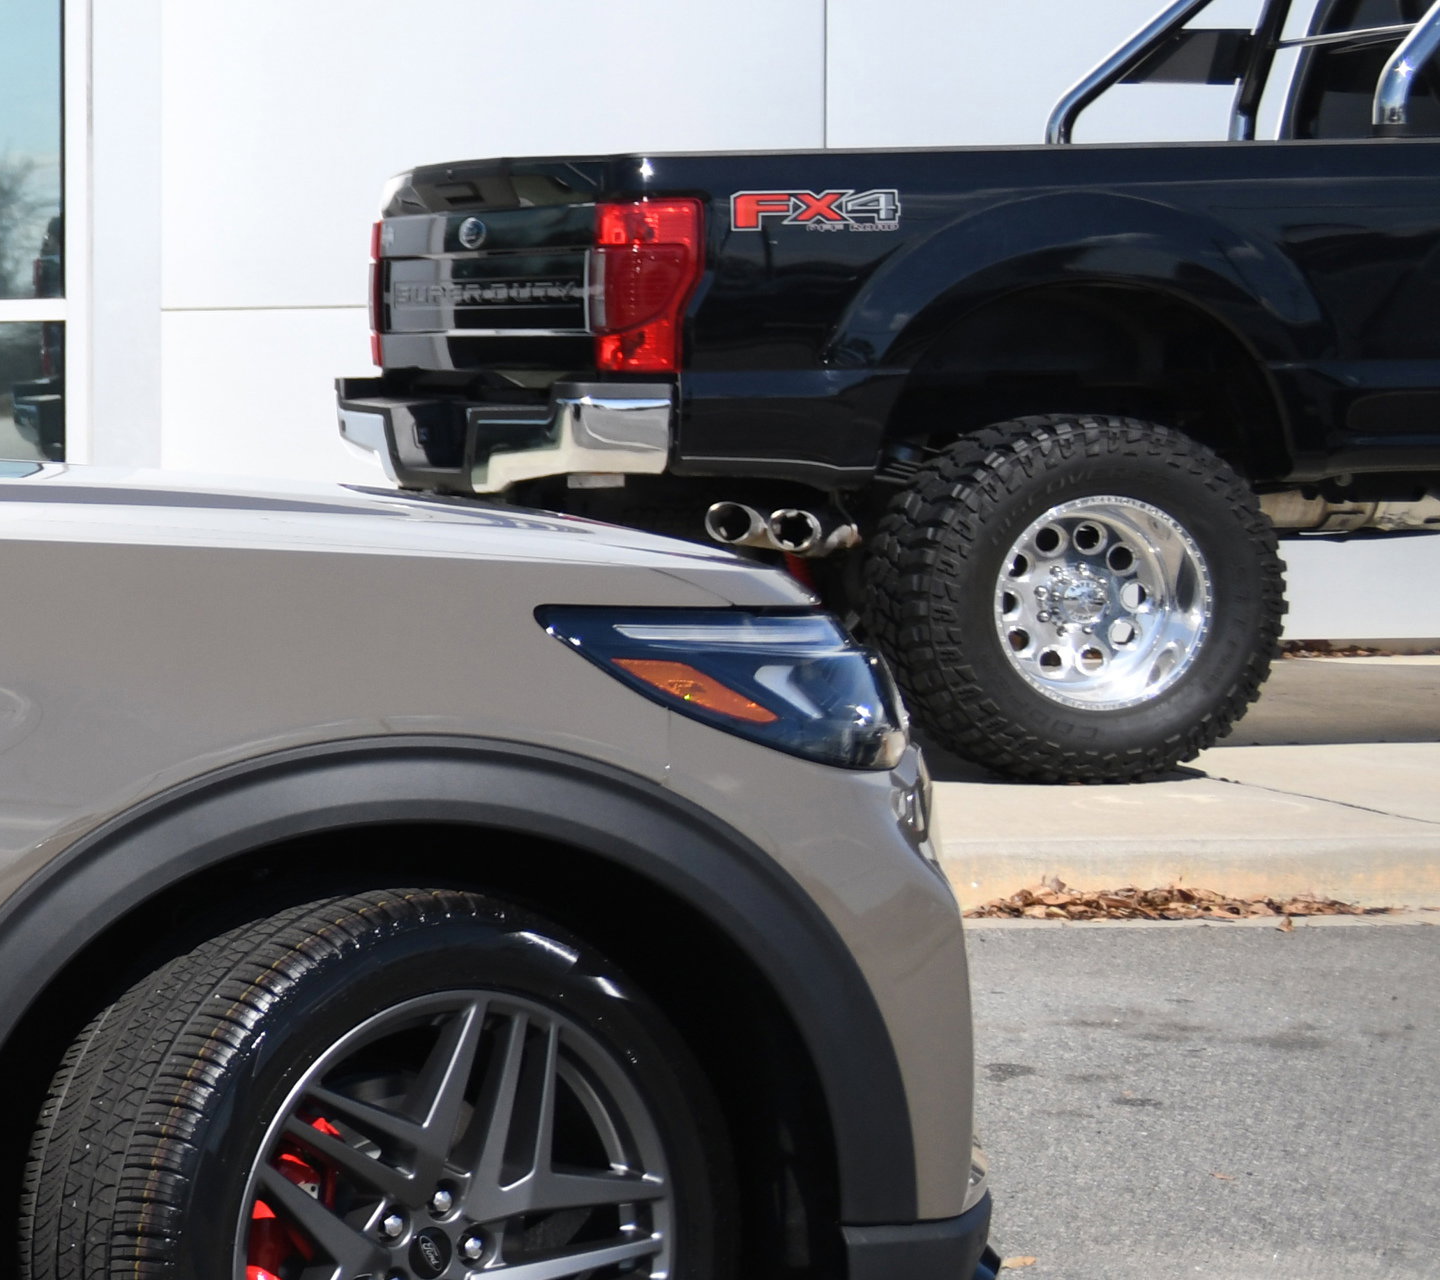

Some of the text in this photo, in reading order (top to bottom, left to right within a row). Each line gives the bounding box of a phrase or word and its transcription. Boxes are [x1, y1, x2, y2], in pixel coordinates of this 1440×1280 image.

[729, 188, 902, 232] FX4
[396, 280, 578, 305] SUPER DUTY
